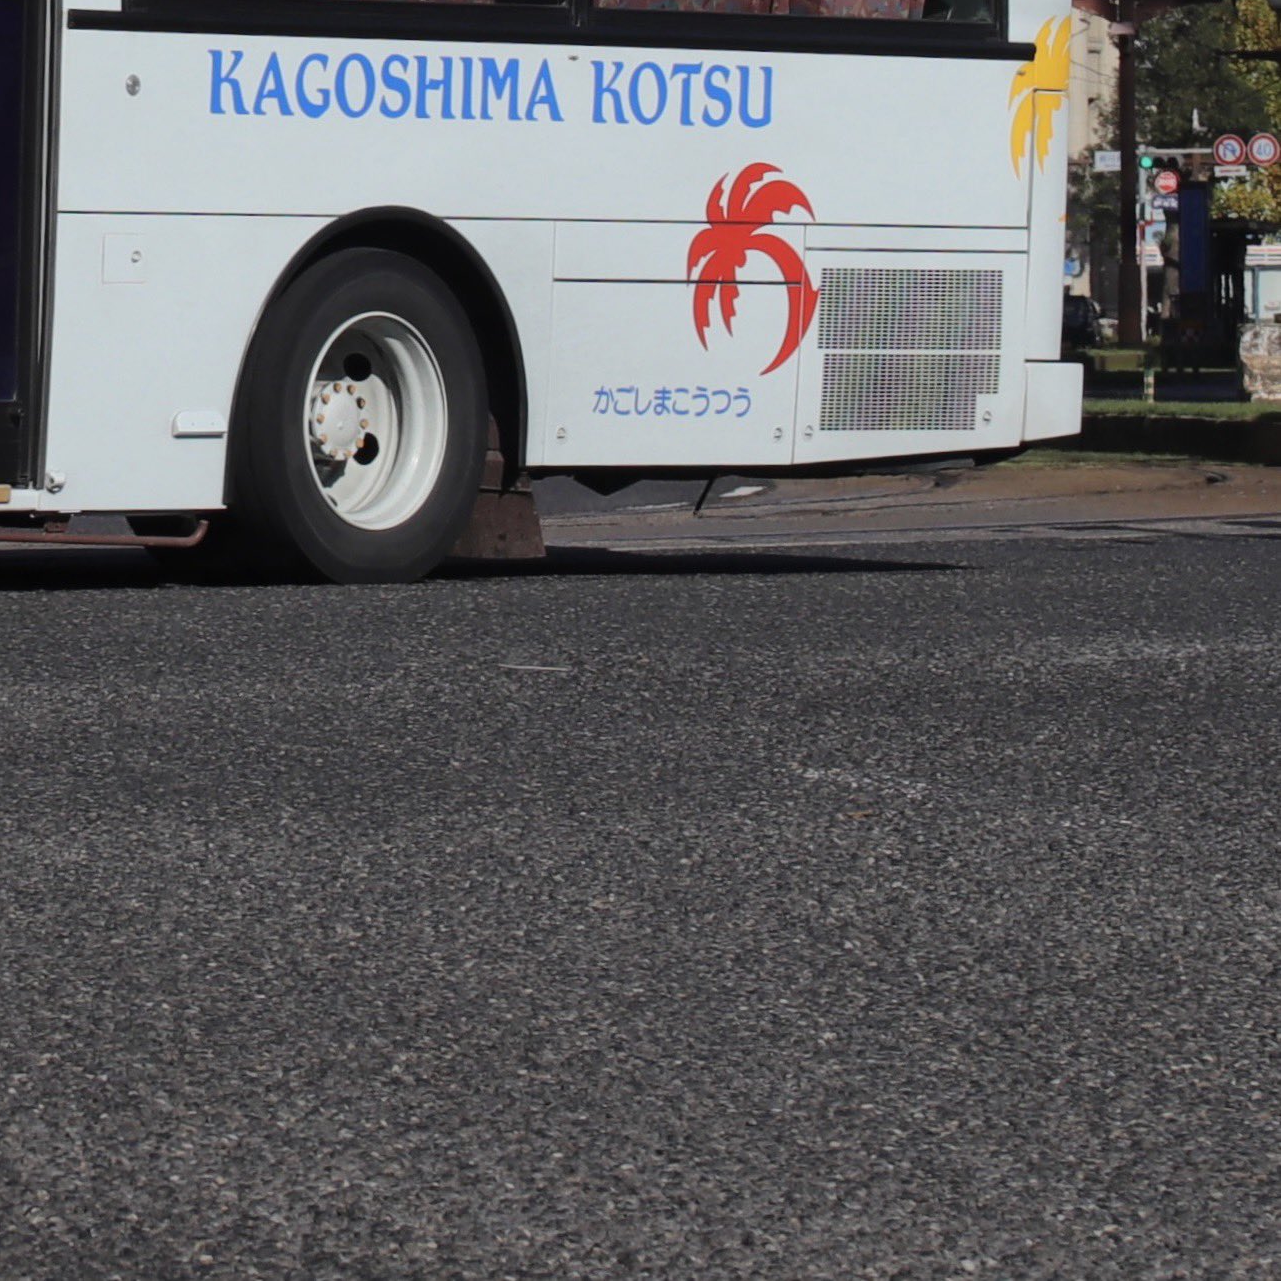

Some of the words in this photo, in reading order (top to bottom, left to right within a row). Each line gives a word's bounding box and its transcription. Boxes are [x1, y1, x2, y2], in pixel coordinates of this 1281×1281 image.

[208, 48, 564, 123] KAGOSHIMA
[591, 59, 774, 129] KOTSU
[591, 383, 753, 418] かごしまこうつう
